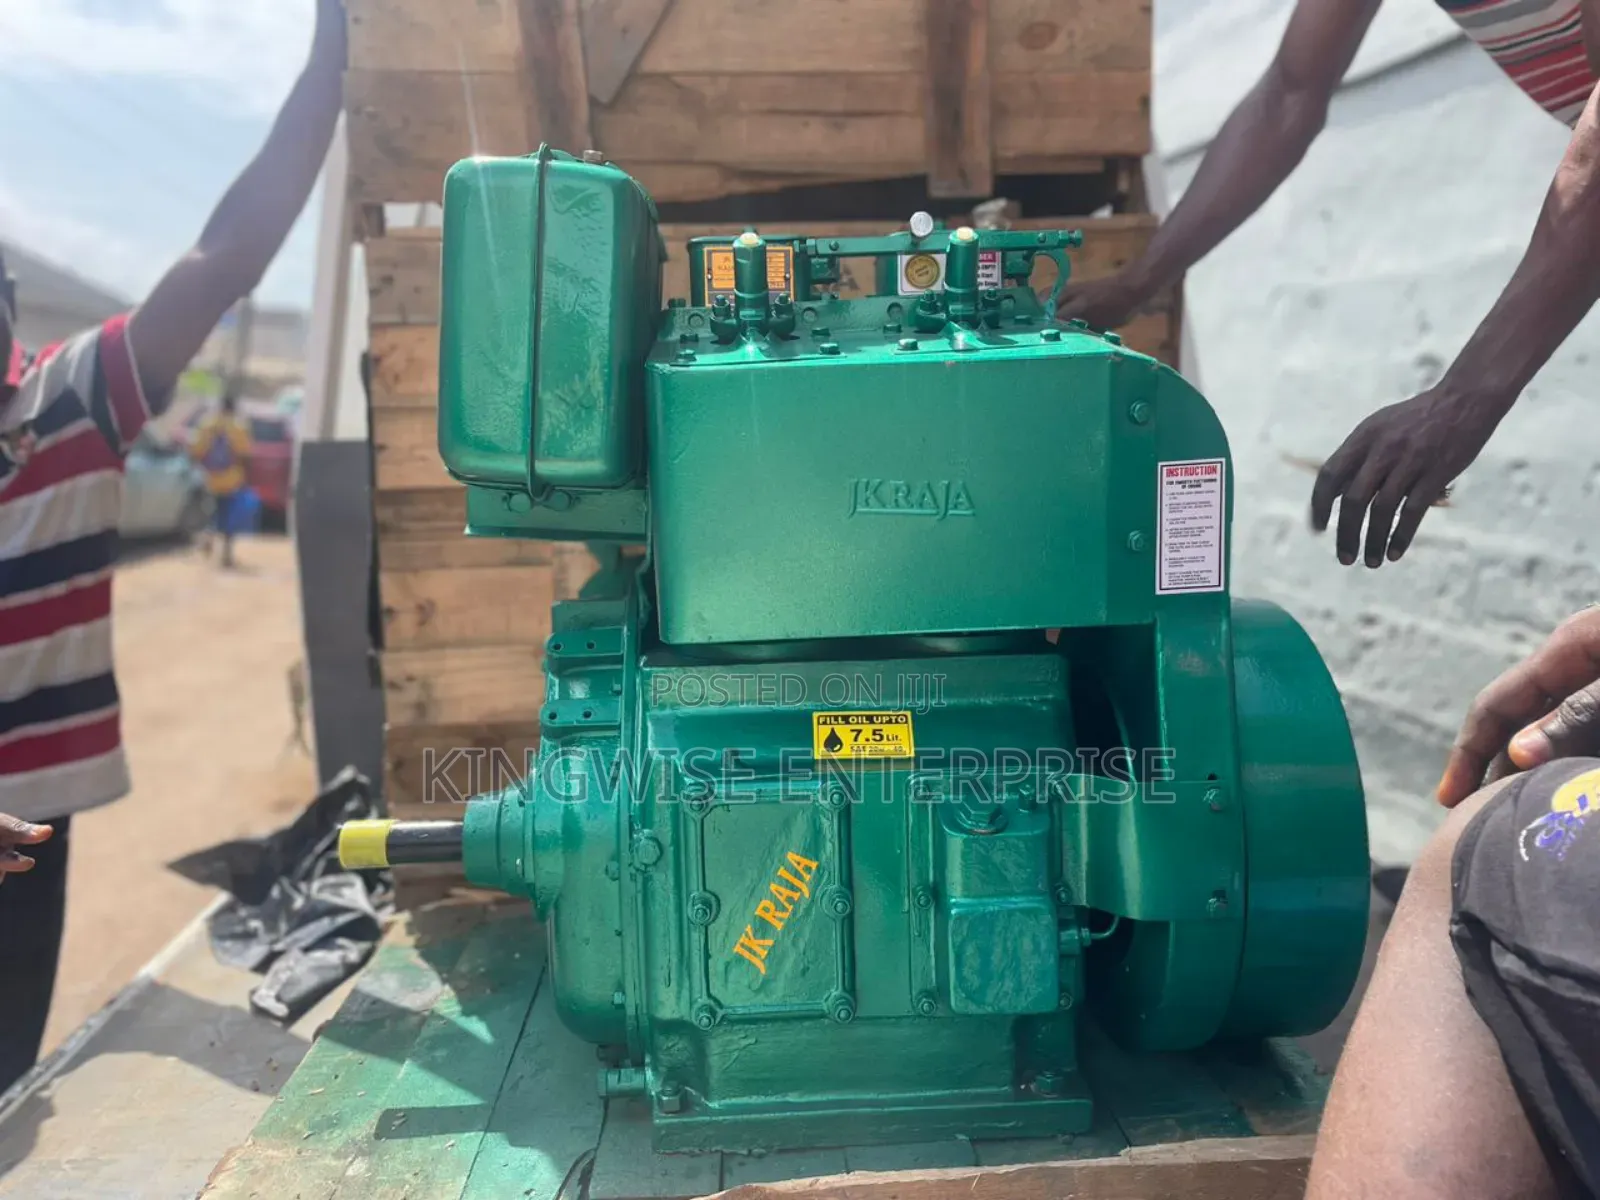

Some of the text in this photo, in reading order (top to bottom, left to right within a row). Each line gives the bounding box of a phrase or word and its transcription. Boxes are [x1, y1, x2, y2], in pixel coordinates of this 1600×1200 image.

[1165, 465, 1217, 478] INSTRUCTION
[819, 715, 907, 725] FILL OIL UPTO
[850, 728, 902, 743] 7.5 Lit.
[733, 851, 819, 976] JK RAJA
